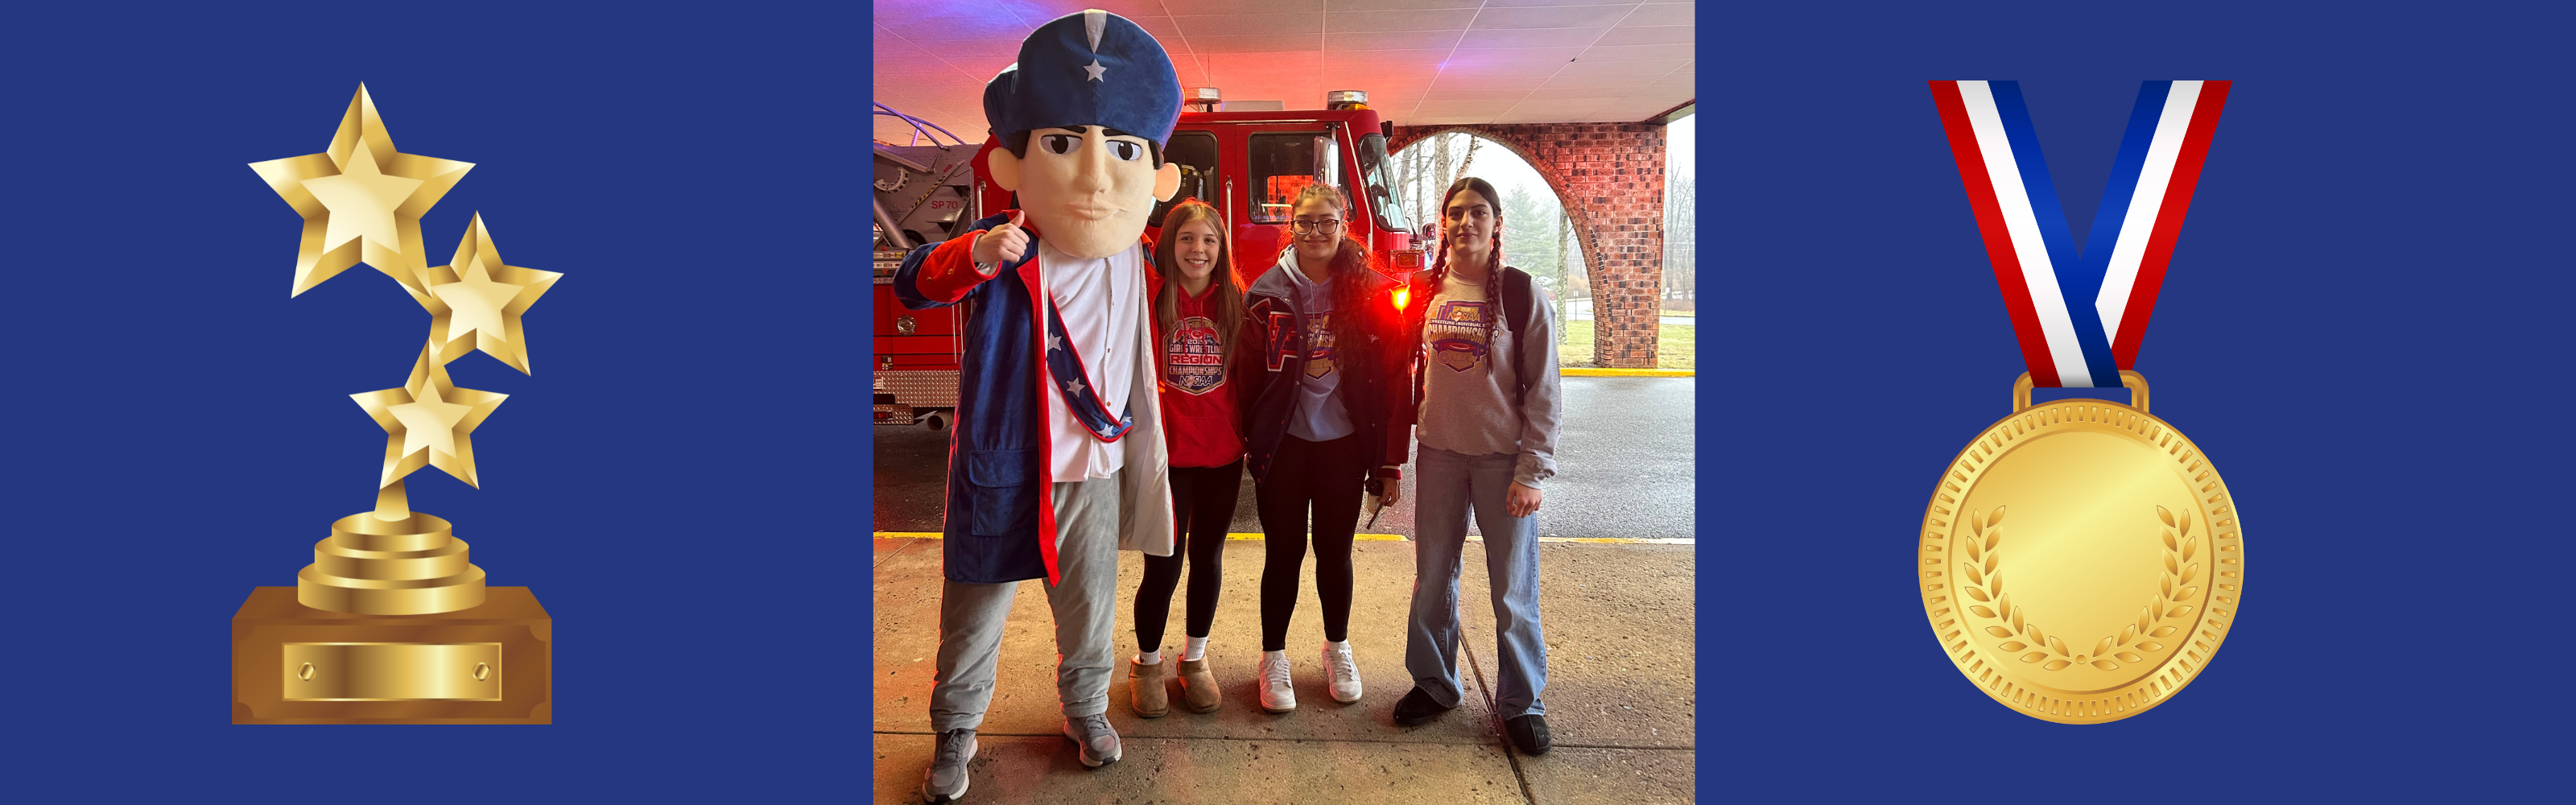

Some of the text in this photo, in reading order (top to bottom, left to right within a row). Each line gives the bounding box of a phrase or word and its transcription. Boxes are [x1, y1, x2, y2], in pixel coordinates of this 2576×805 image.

[931, 200, 958, 209] SP 70
[1428, 324, 1500, 346] CHAMPIONSHIS
[1170, 344, 1224, 353] GIRLS WRETLIN
[1170, 354, 1223, 365] REGION
[1169, 365, 1223, 376] CHAMPIONSHIPS
